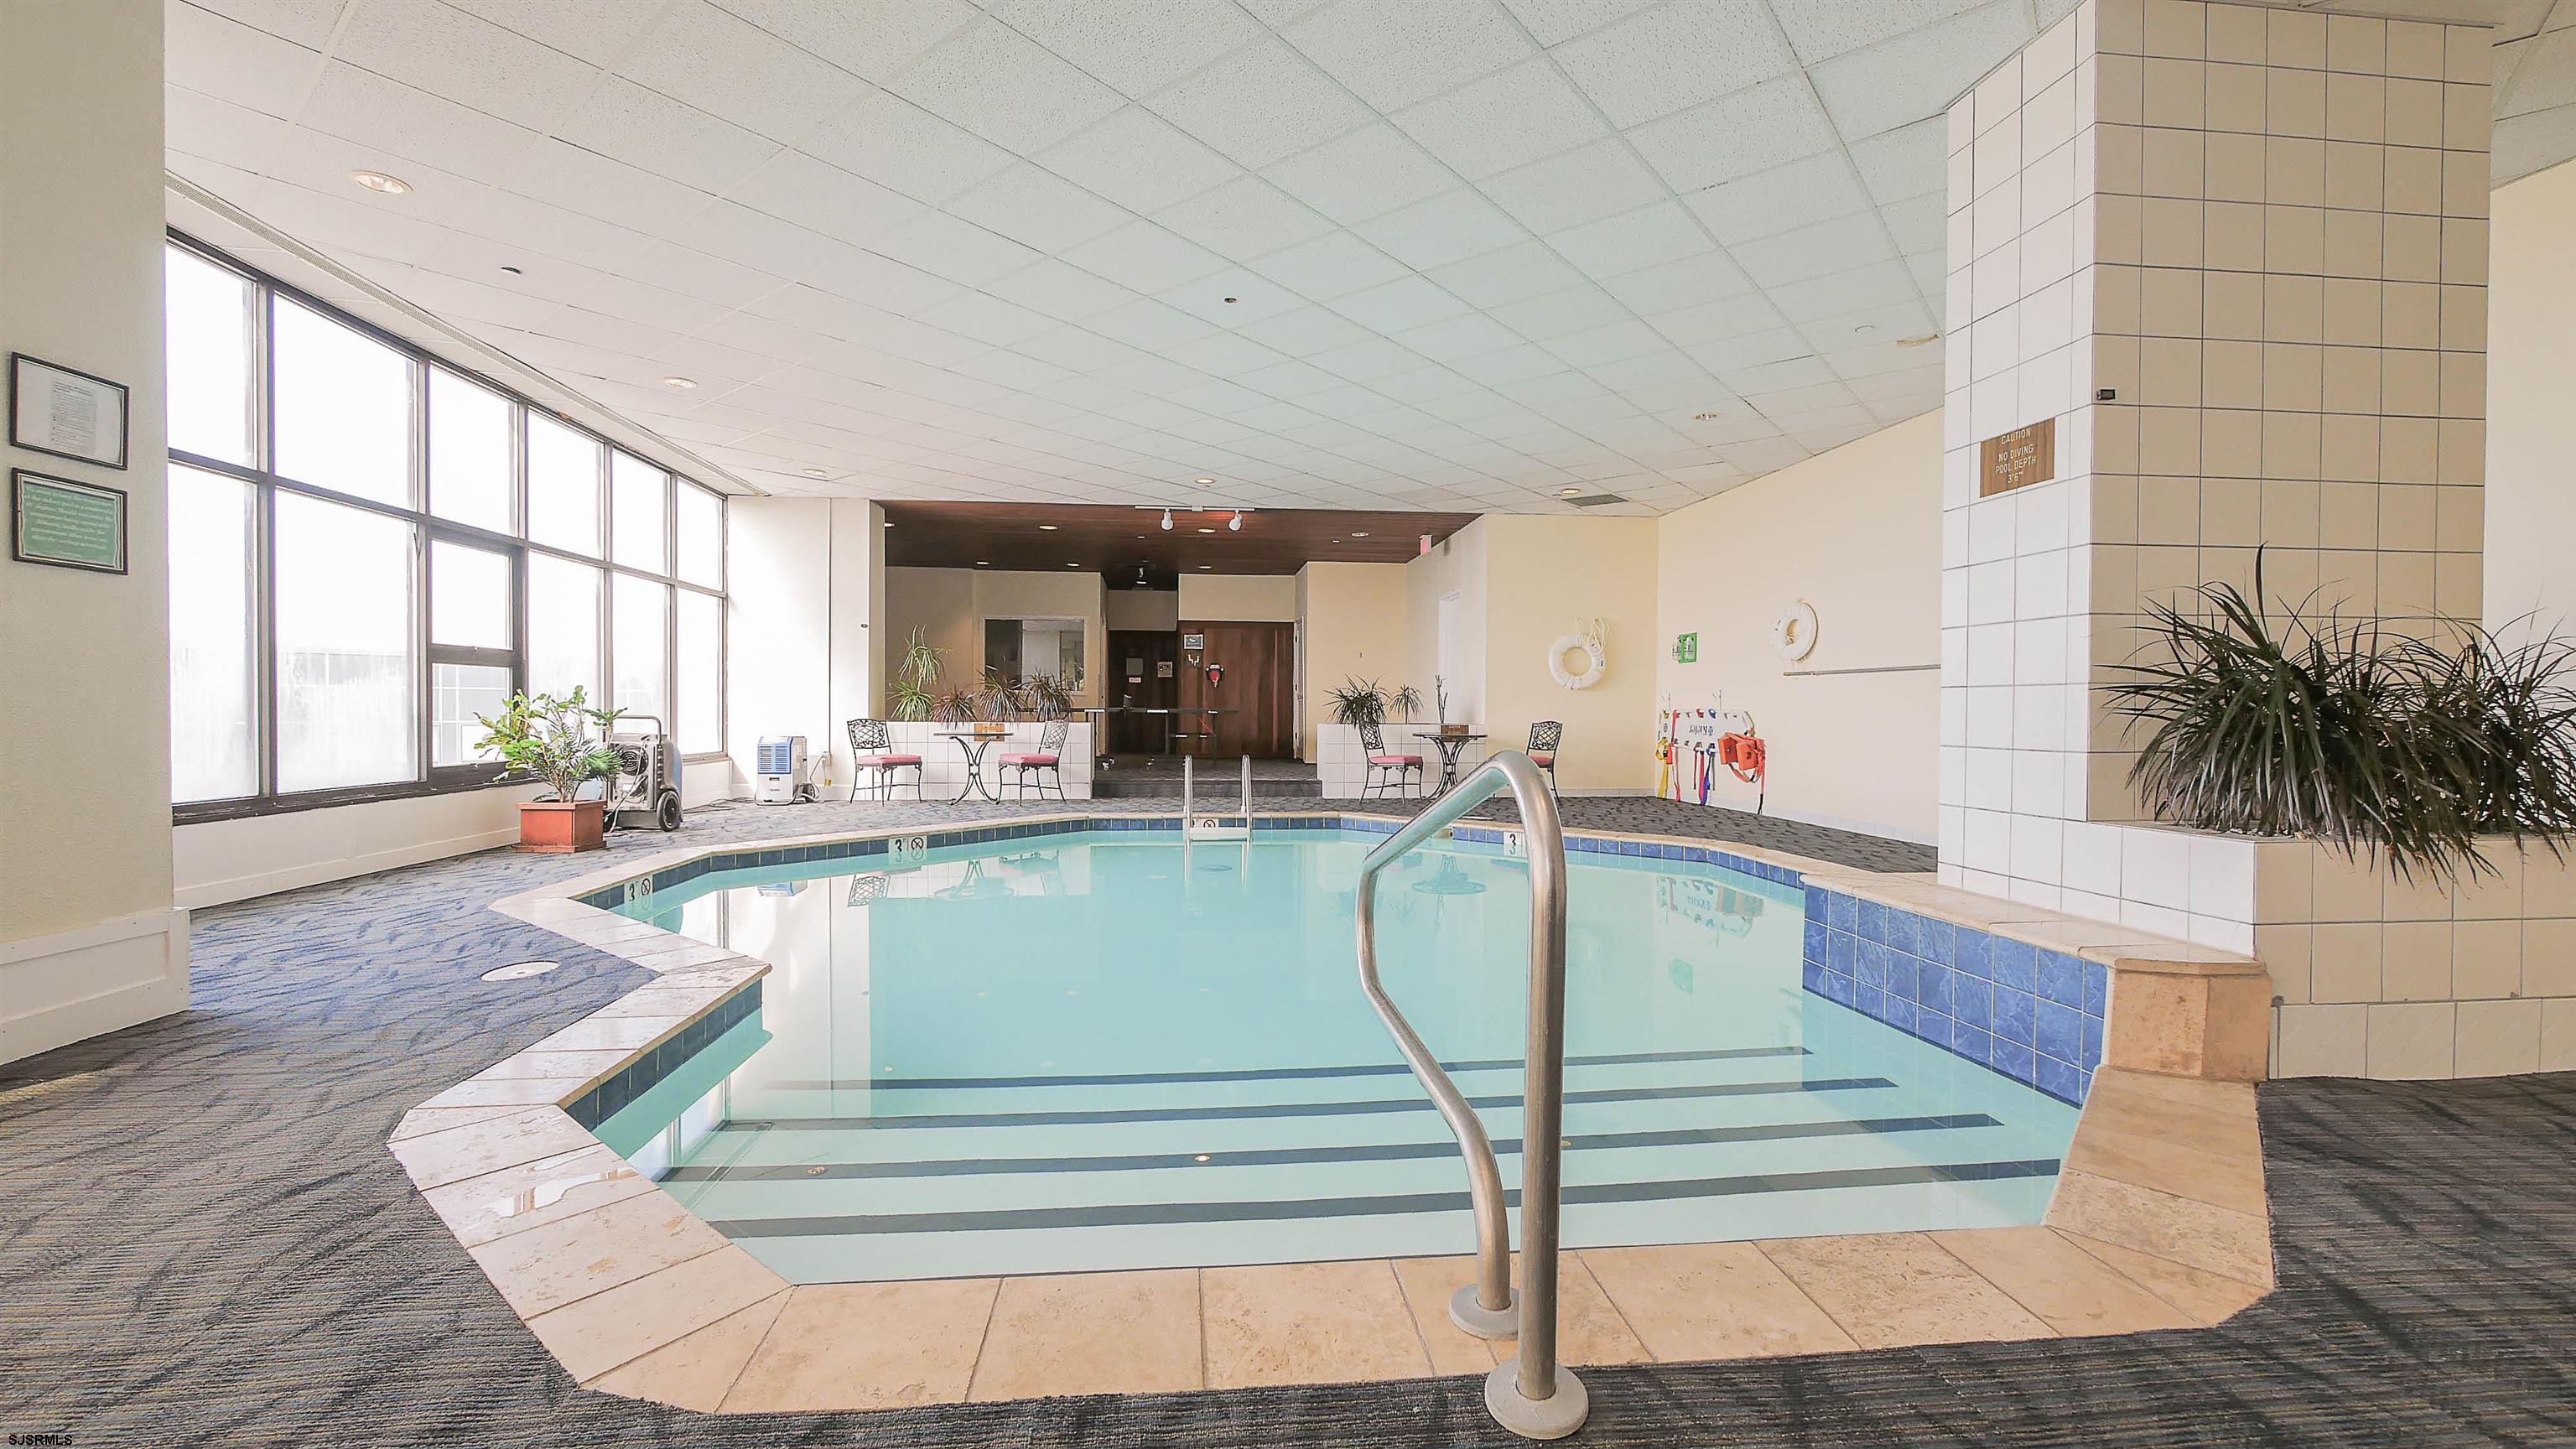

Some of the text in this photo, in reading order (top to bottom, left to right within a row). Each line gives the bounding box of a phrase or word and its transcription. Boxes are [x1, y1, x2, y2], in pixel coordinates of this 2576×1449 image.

[2001, 428, 2031, 444] CAUTION
[1998, 444, 2033, 462] NO DIVING
[1995, 456, 2036, 475] POOL DEPTH
[895, 839, 902, 852] 3
[1509, 834, 1516, 846] 3
[629, 883, 635, 901] 3
